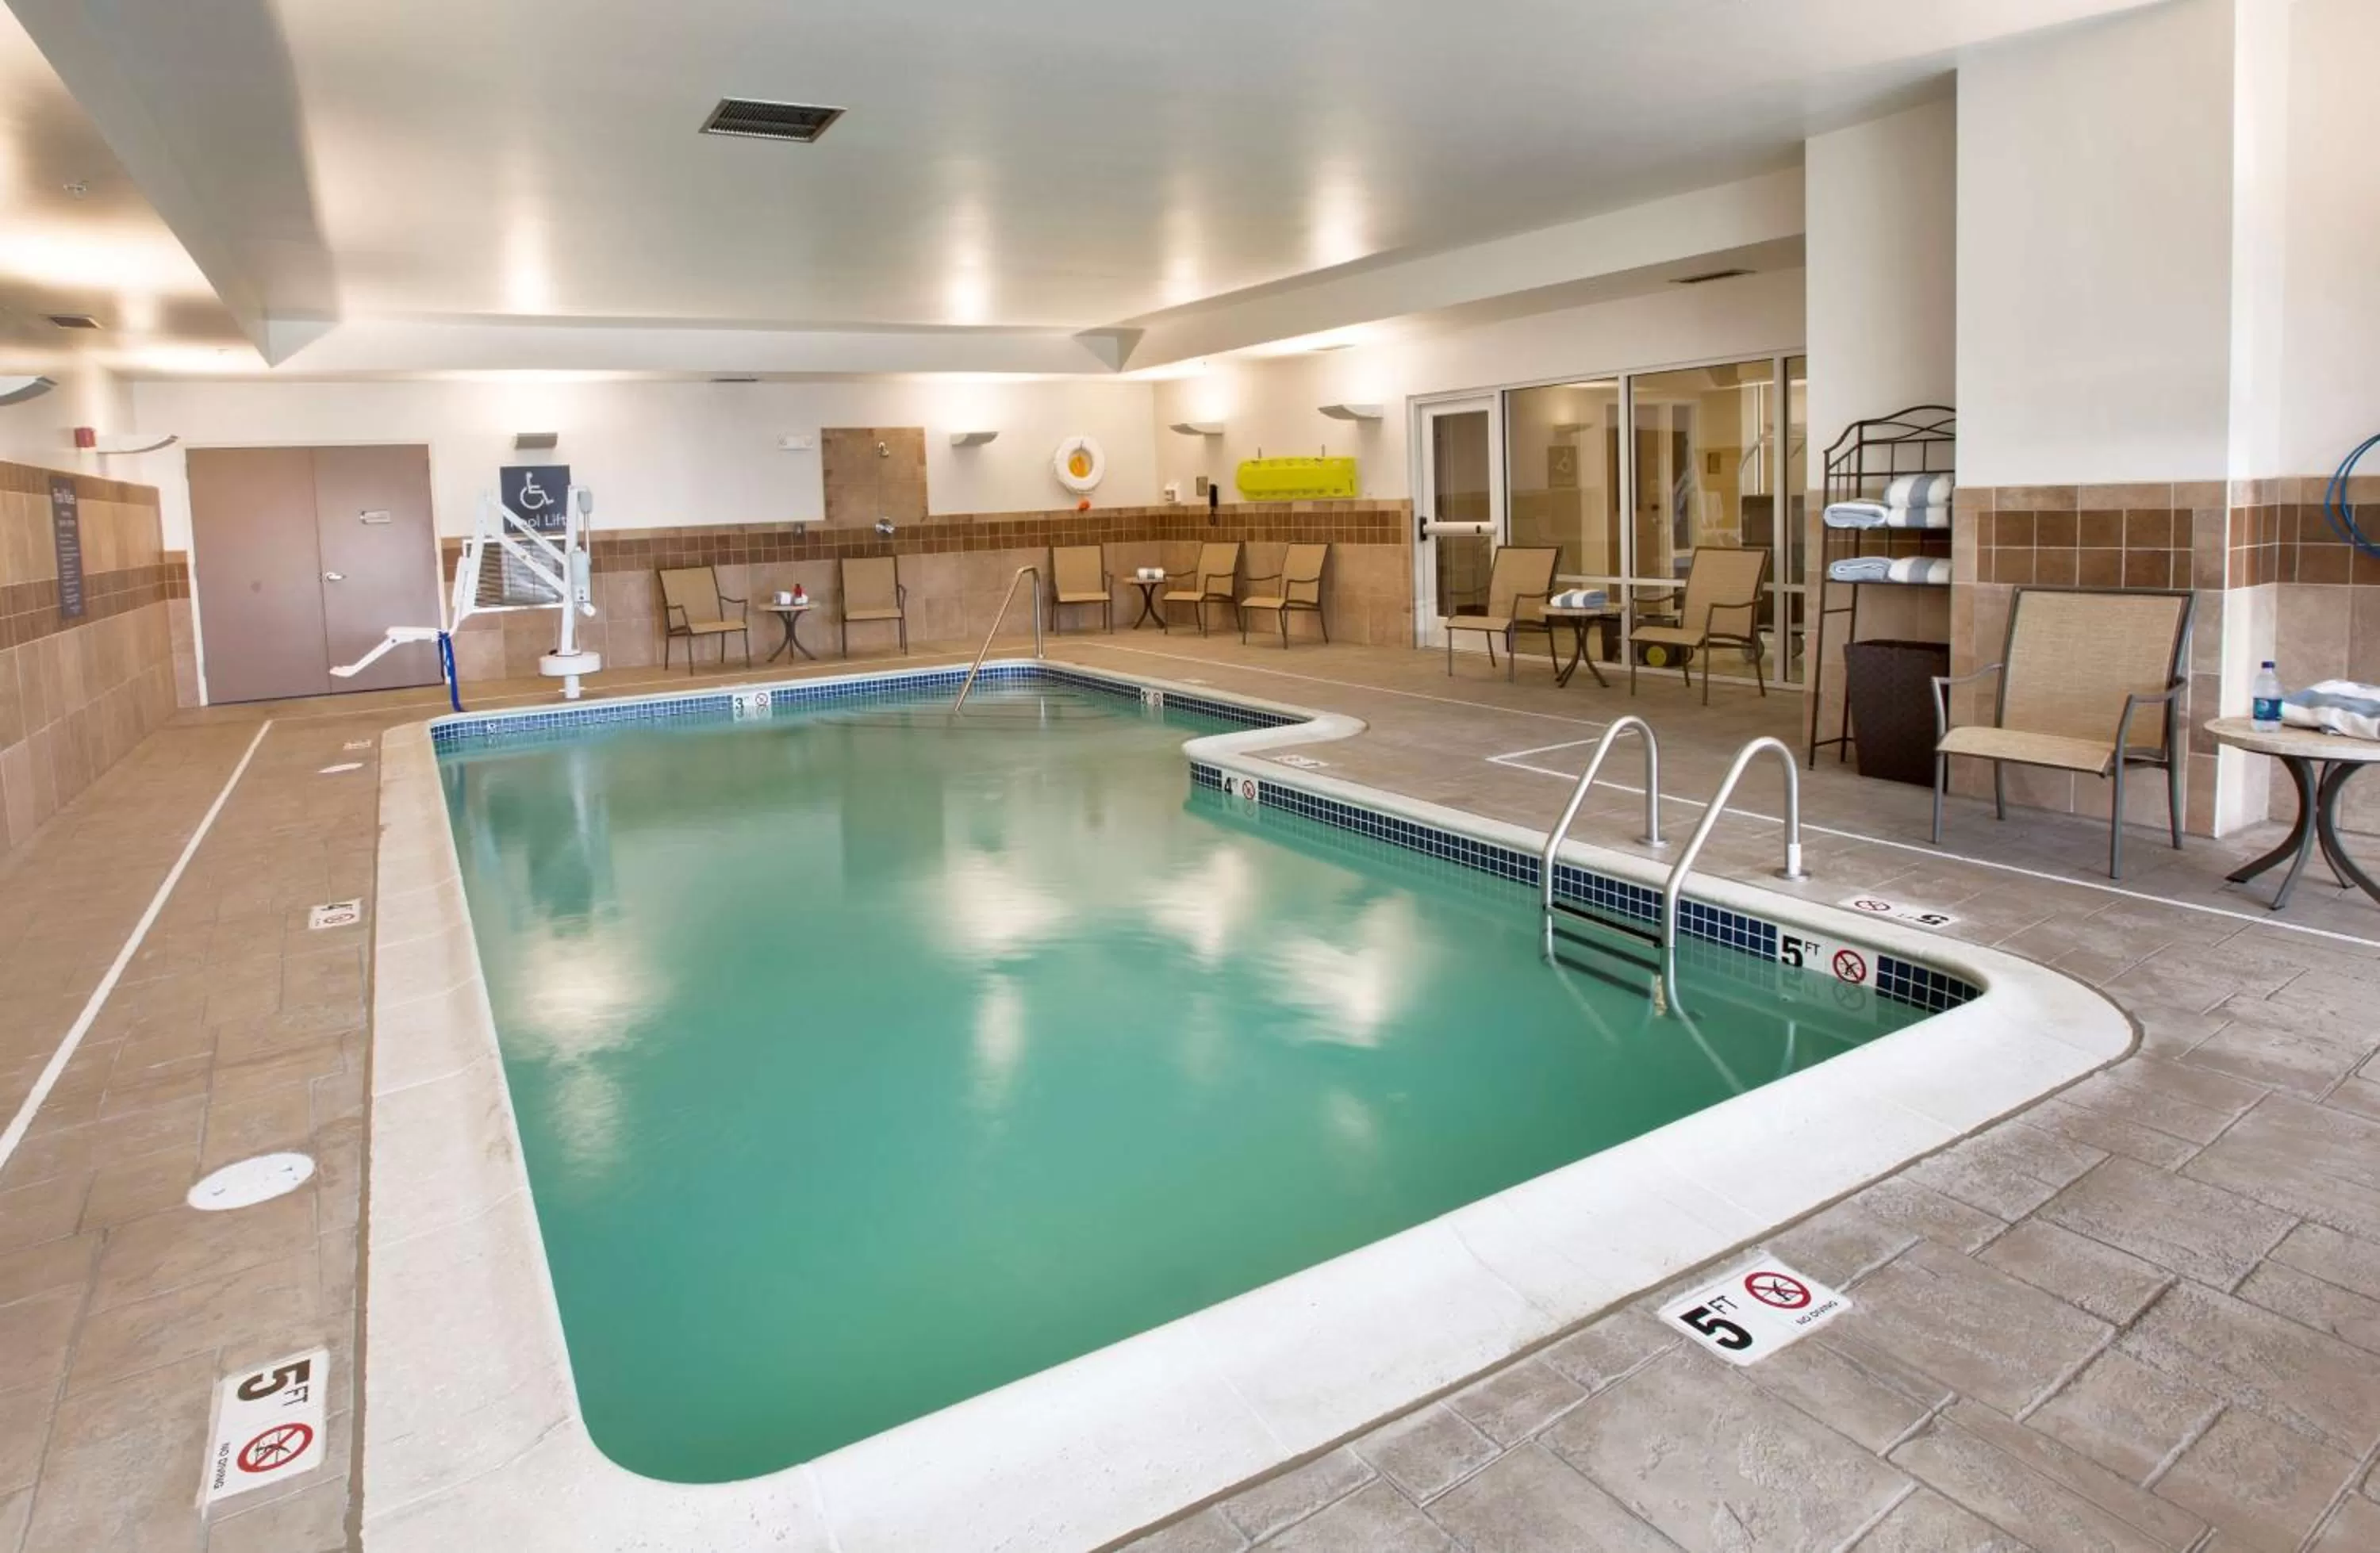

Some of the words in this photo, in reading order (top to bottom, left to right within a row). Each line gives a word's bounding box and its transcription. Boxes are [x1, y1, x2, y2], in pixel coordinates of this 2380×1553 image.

[735, 697, 744, 710] 3
[1224, 776, 1232, 794] 4
[1781, 934, 1803, 967] 5
[1804, 941, 1821, 956] FT
[1707, 1294, 1739, 1315] FT
[1679, 1306, 1752, 1350] 5
[236, 1359, 311, 1402] 5
[282, 1385, 309, 1407] FT
[218, 1441, 231, 1457] NO
[213, 1457, 228, 1490] DIVING
